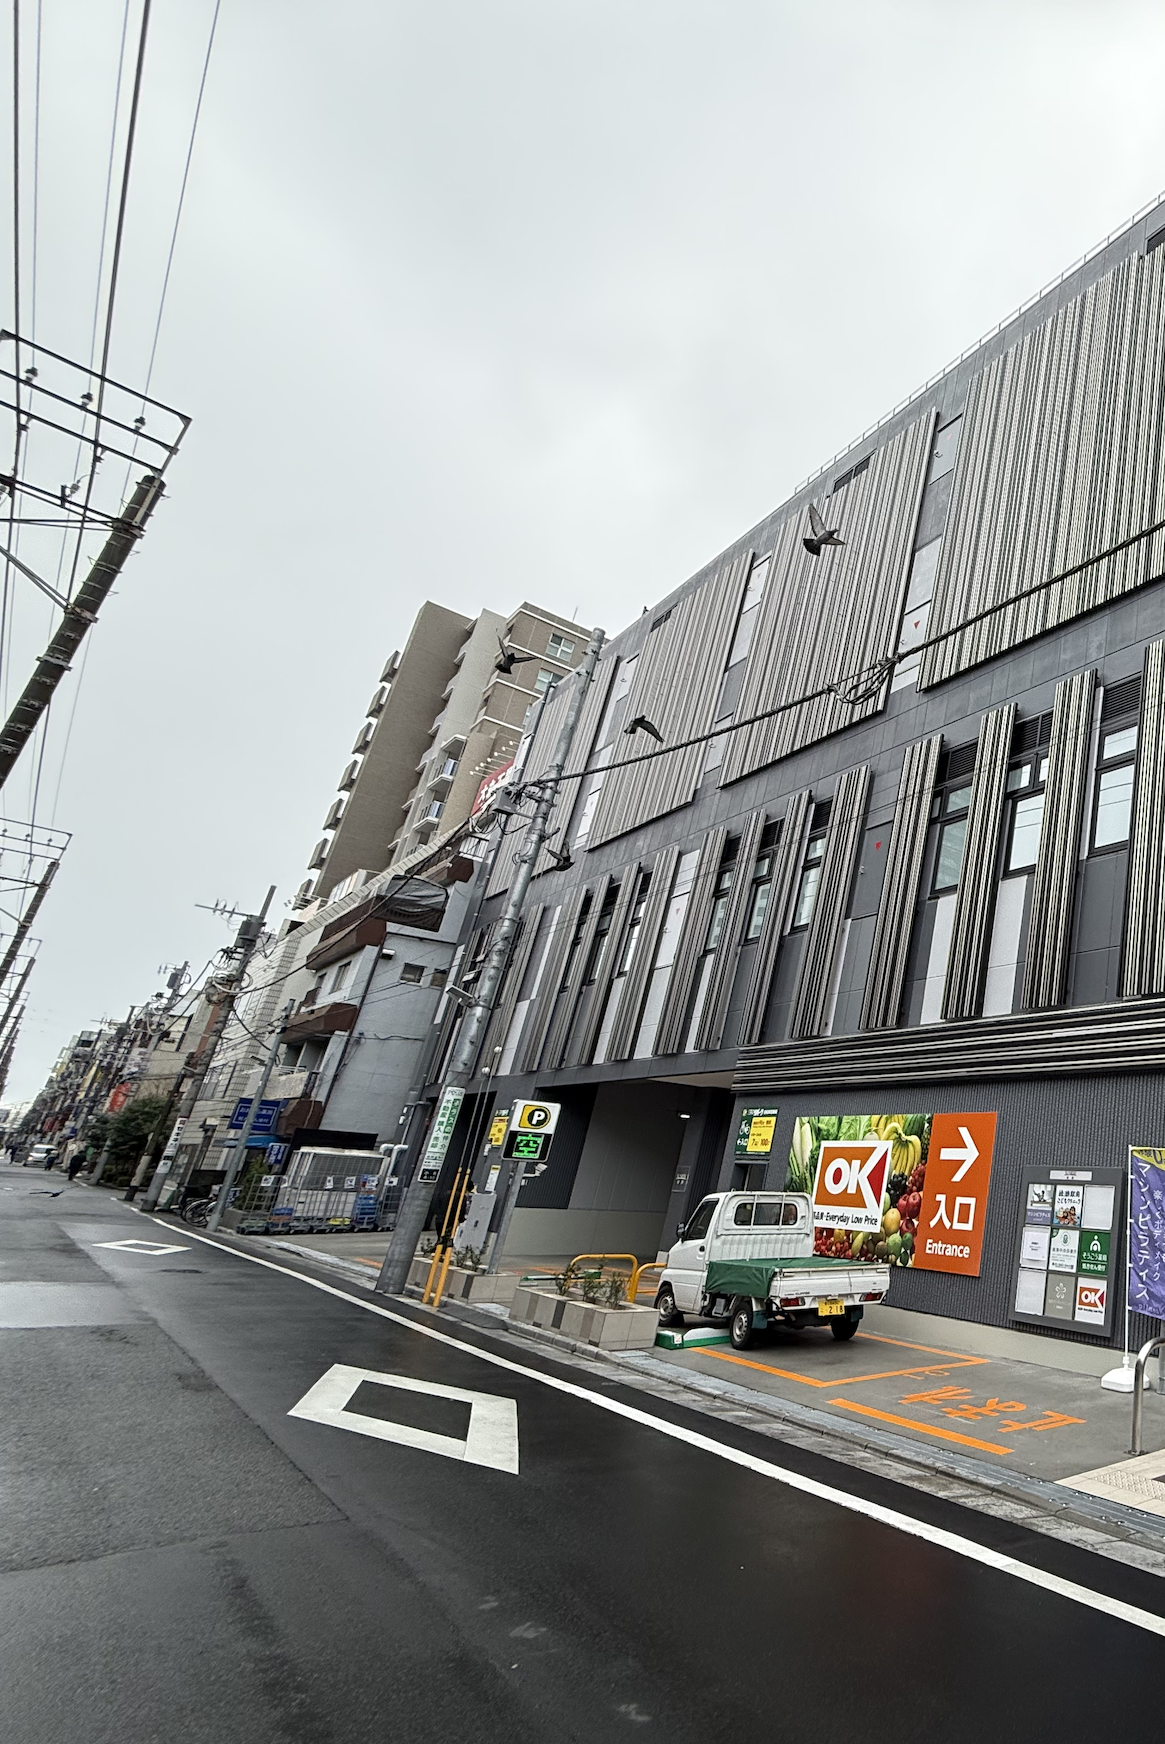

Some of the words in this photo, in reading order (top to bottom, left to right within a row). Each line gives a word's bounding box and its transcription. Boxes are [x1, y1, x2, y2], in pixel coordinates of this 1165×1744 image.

[531, 1110, 546, 1125] P
[851, 1213, 863, 1224] Low
[864, 1215, 879, 1226] Price
[930, 1194, 976, 1231] 入口
[1136, 1162, 1151, 1300] マシンピラティス
[925, 1239, 970, 1258] Entrance
